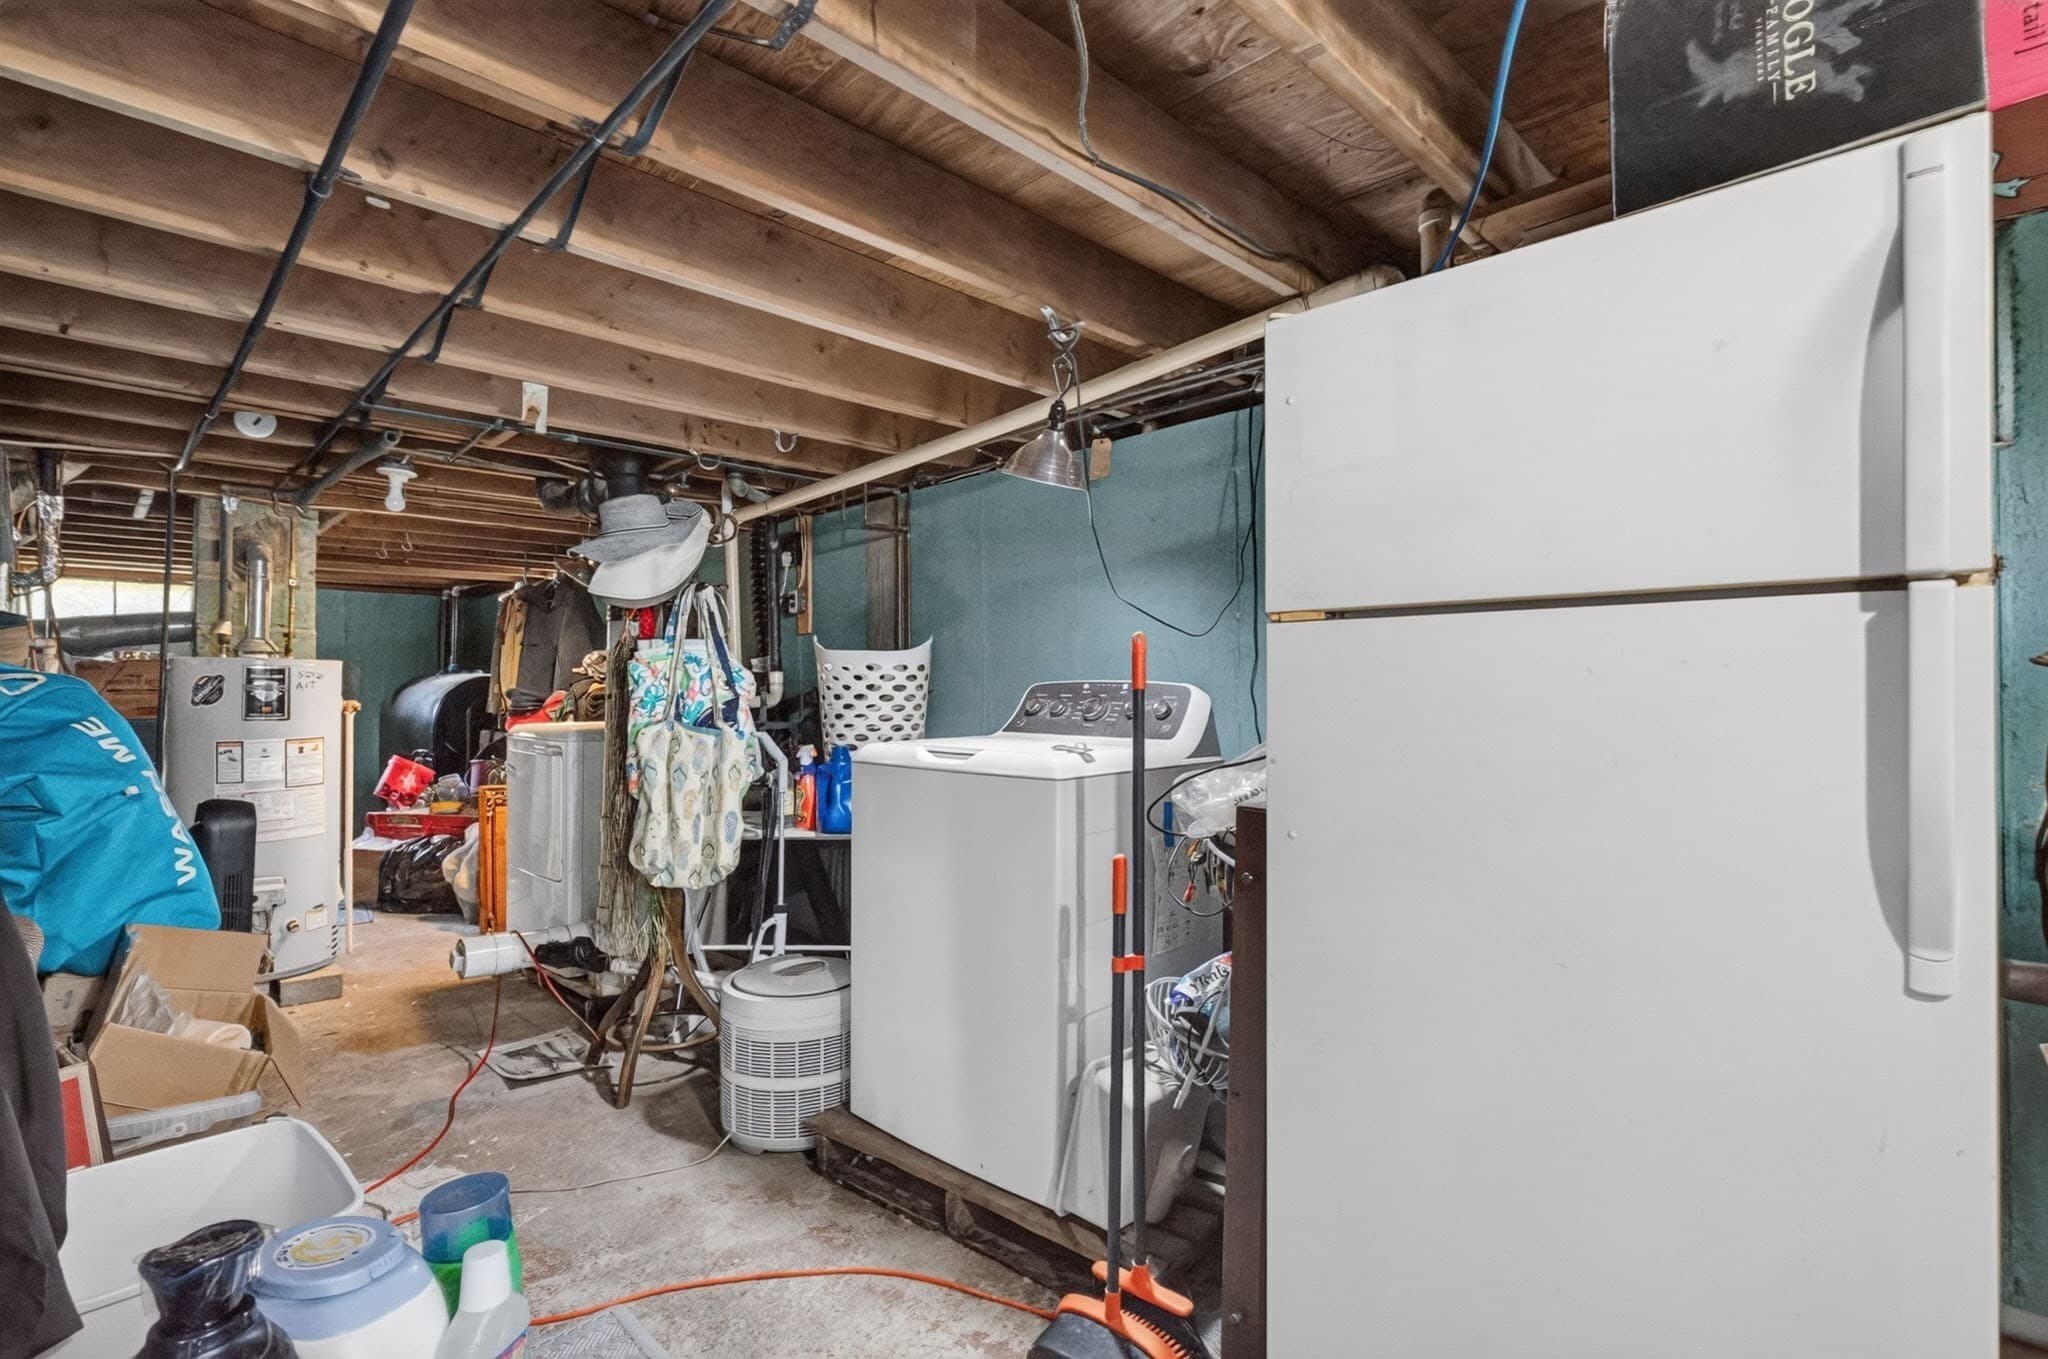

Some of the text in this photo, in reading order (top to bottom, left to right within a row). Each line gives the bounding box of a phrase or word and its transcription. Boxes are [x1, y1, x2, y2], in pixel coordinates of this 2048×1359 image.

[1766, 4, 1781, 81] FAMILY
[1783, 0, 1816, 100] OGLE
[70, 716, 137, 763] ME
[141, 770, 197, 887] WA
